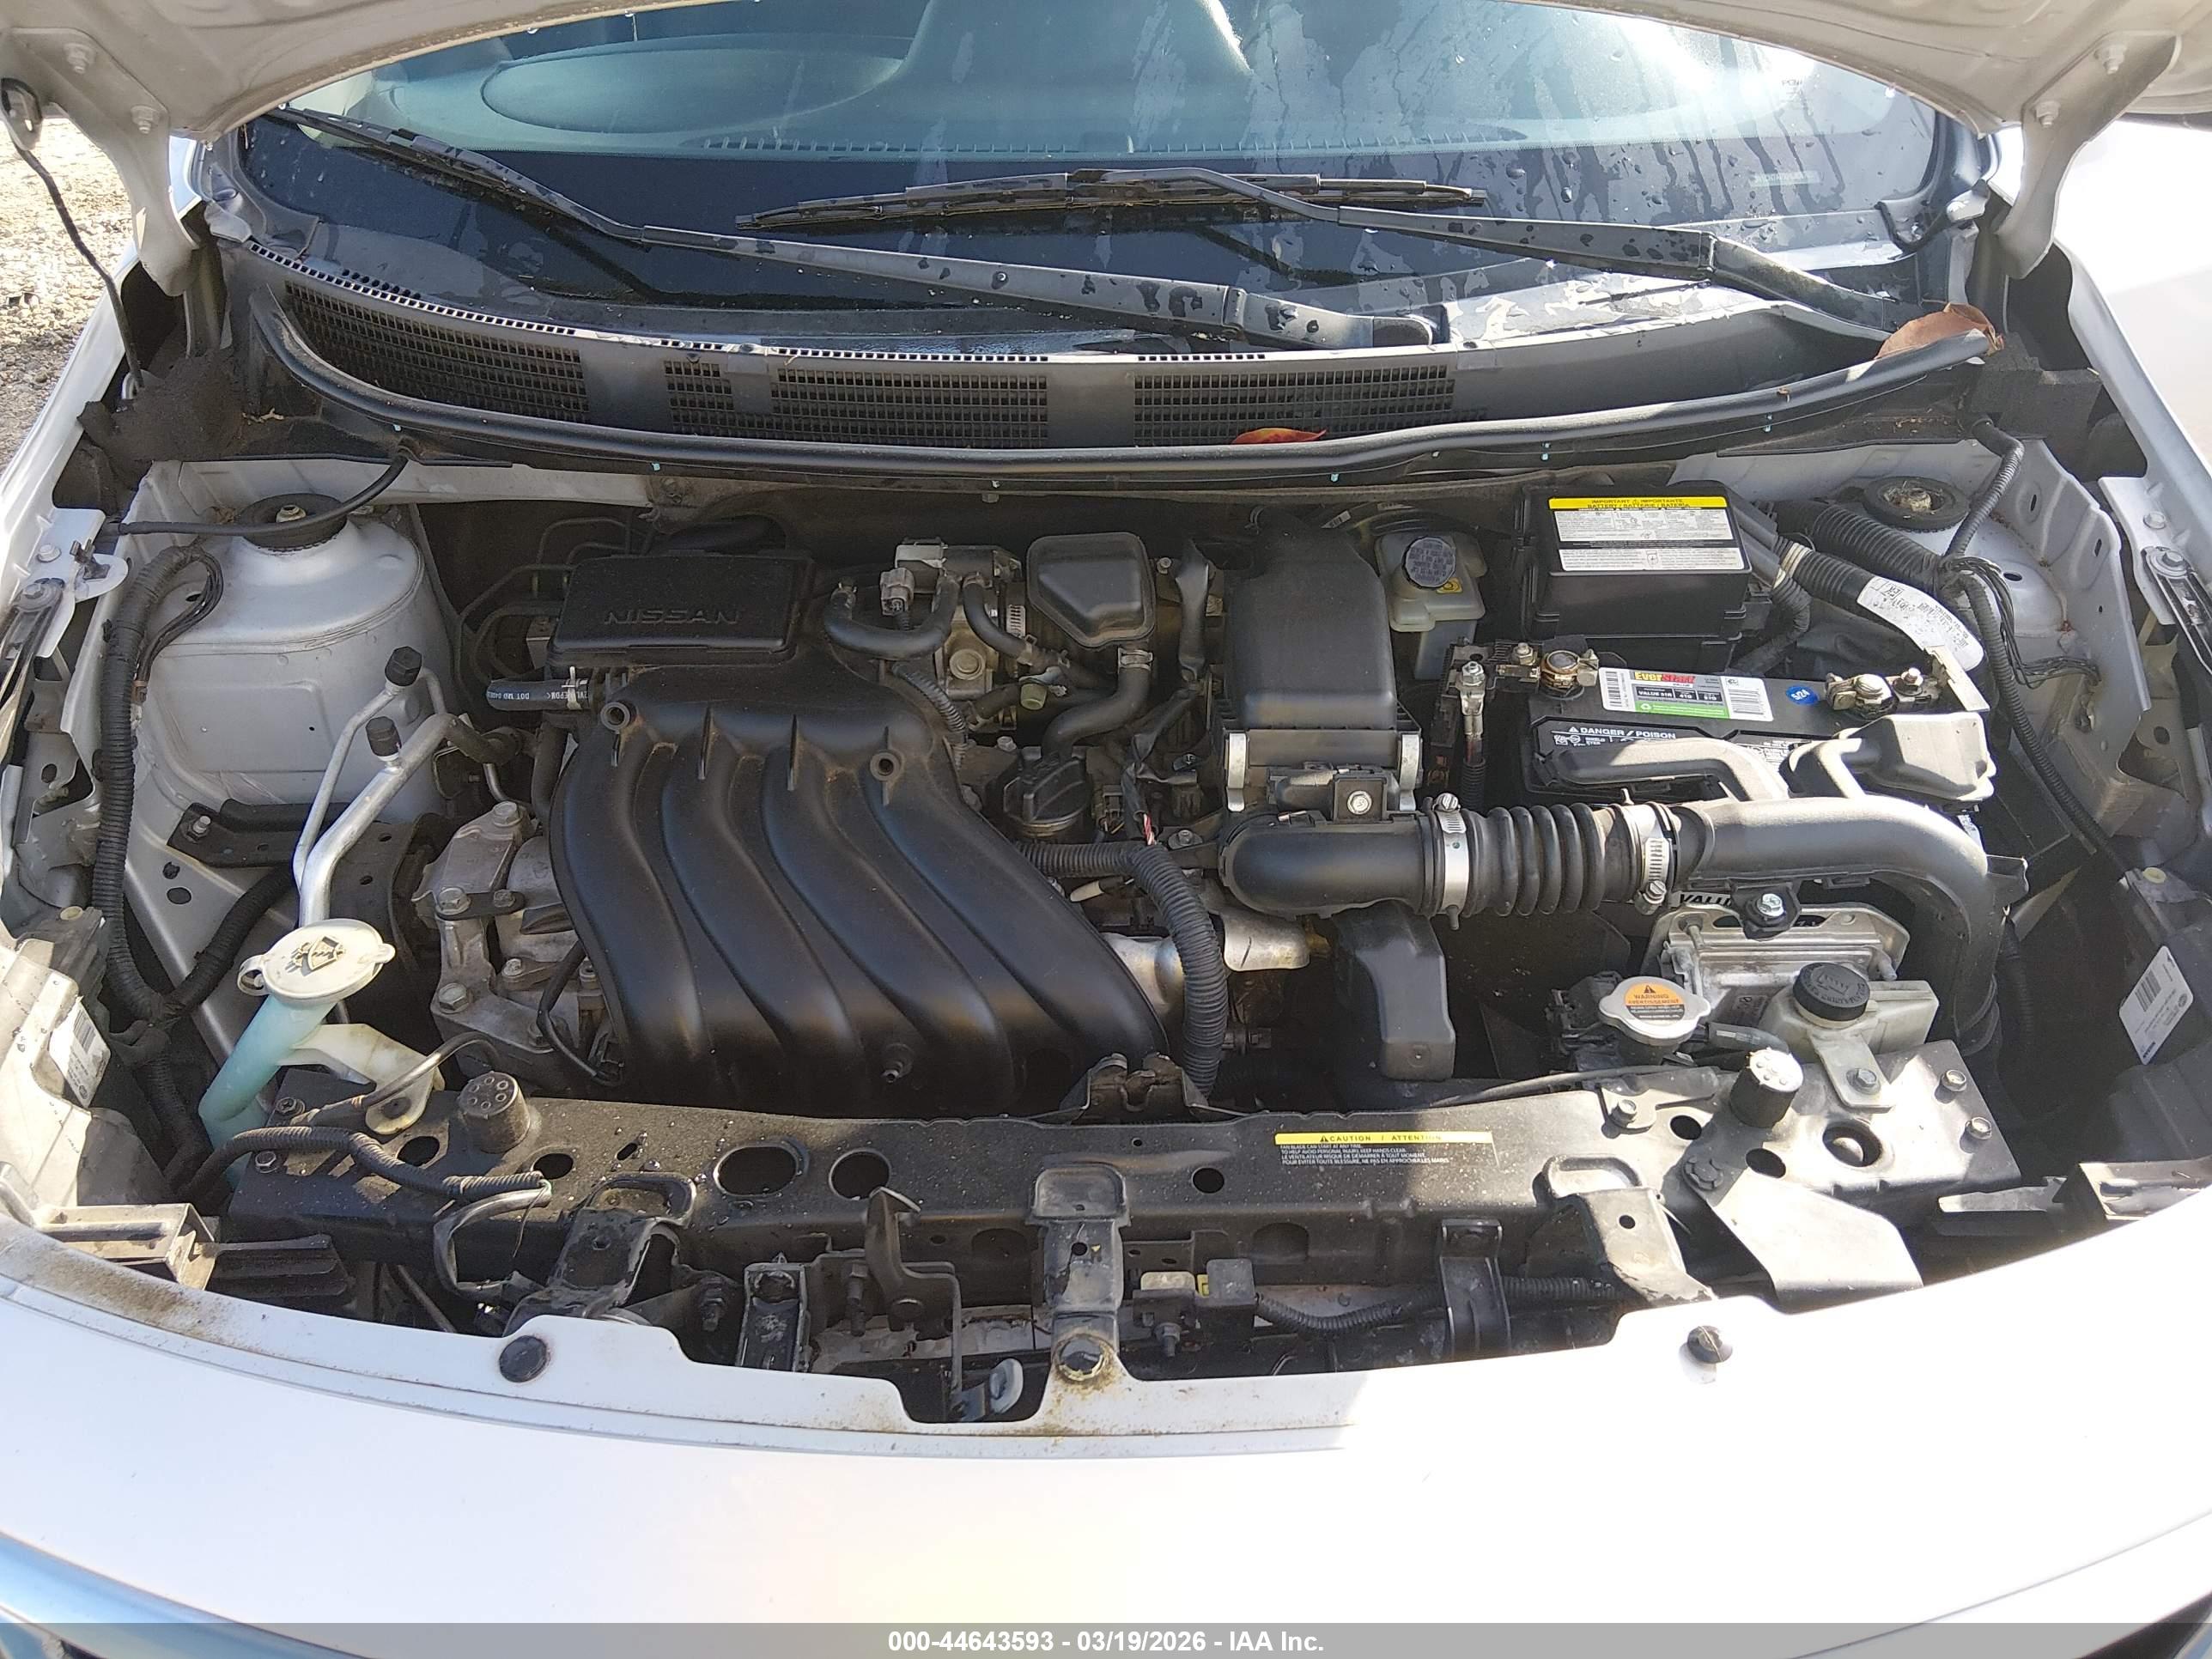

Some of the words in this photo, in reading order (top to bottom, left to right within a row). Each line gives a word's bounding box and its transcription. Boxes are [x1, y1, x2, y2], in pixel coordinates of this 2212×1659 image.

[604, 609, 741, 624] NISSAN
[1634, 672, 1696, 684] EverStart
[1580, 727, 1626, 736] DANGER
[1635, 730, 1676, 739] POISON
[1680, 894, 1731, 907] VALU
